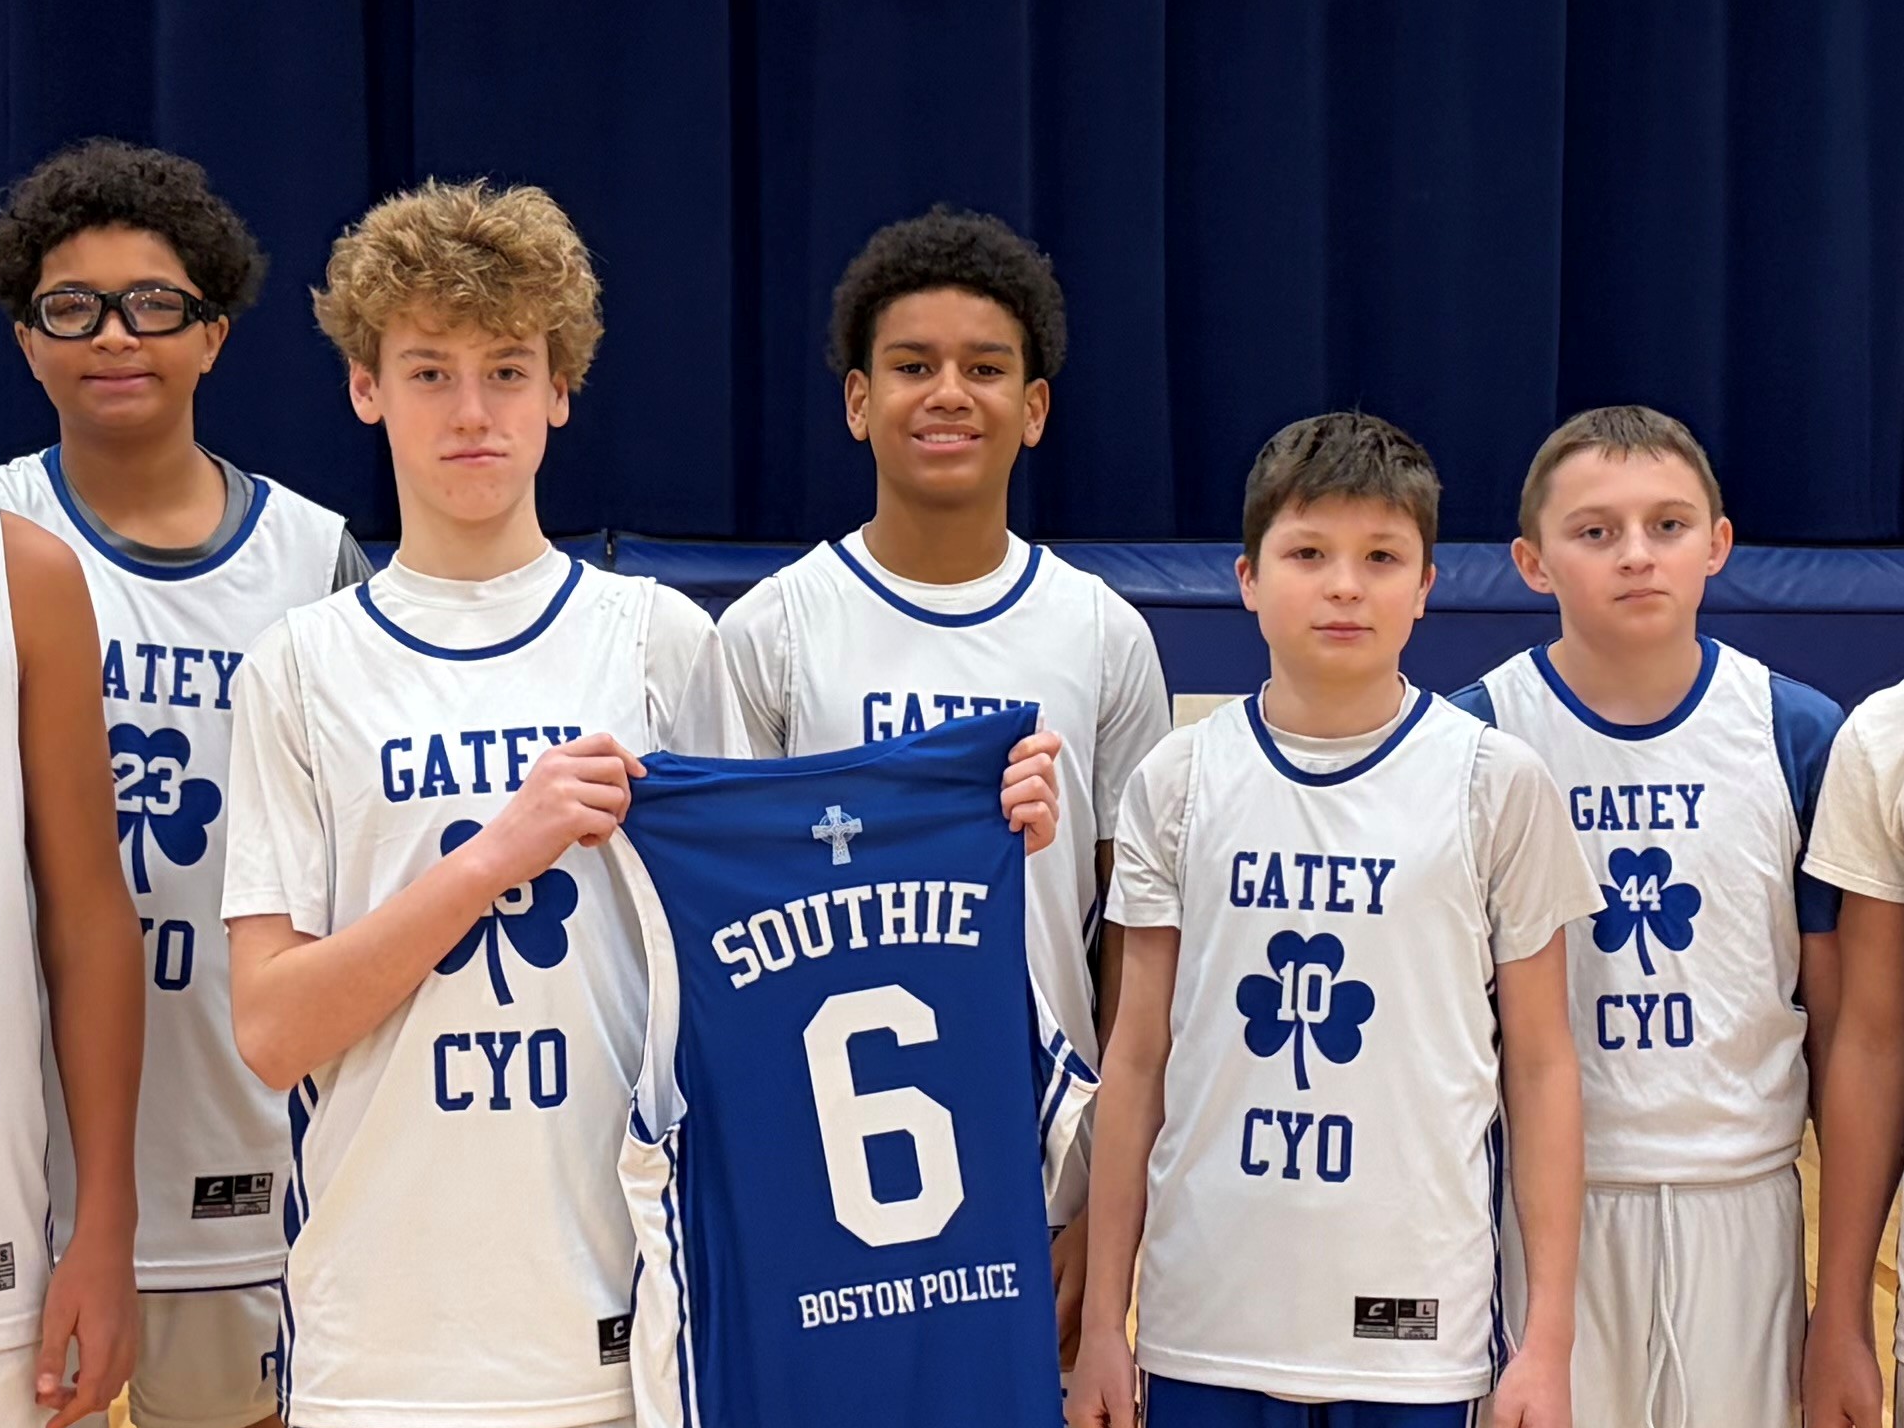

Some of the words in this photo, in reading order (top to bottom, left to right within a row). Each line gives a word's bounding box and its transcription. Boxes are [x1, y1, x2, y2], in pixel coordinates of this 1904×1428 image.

[102, 639, 245, 709] ATEY
[863, 692, 1040, 744] GAT
[112, 752, 183, 815] 23
[1569, 783, 1705, 831] GATEY
[1229, 851, 1396, 916] GATEY
[1619, 873, 1662, 912] 44
[711, 880, 988, 990] SOUTHIE
[1276, 961, 1333, 1024] 10
[1596, 992, 1694, 1050] CYO
[433, 1028, 566, 1112] CYO
[803, 983, 965, 1247] 6
[1240, 1107, 1353, 1183] CYO
[798, 1274, 915, 1329] BOSTON
[920, 1263, 1019, 1310] POLICE
